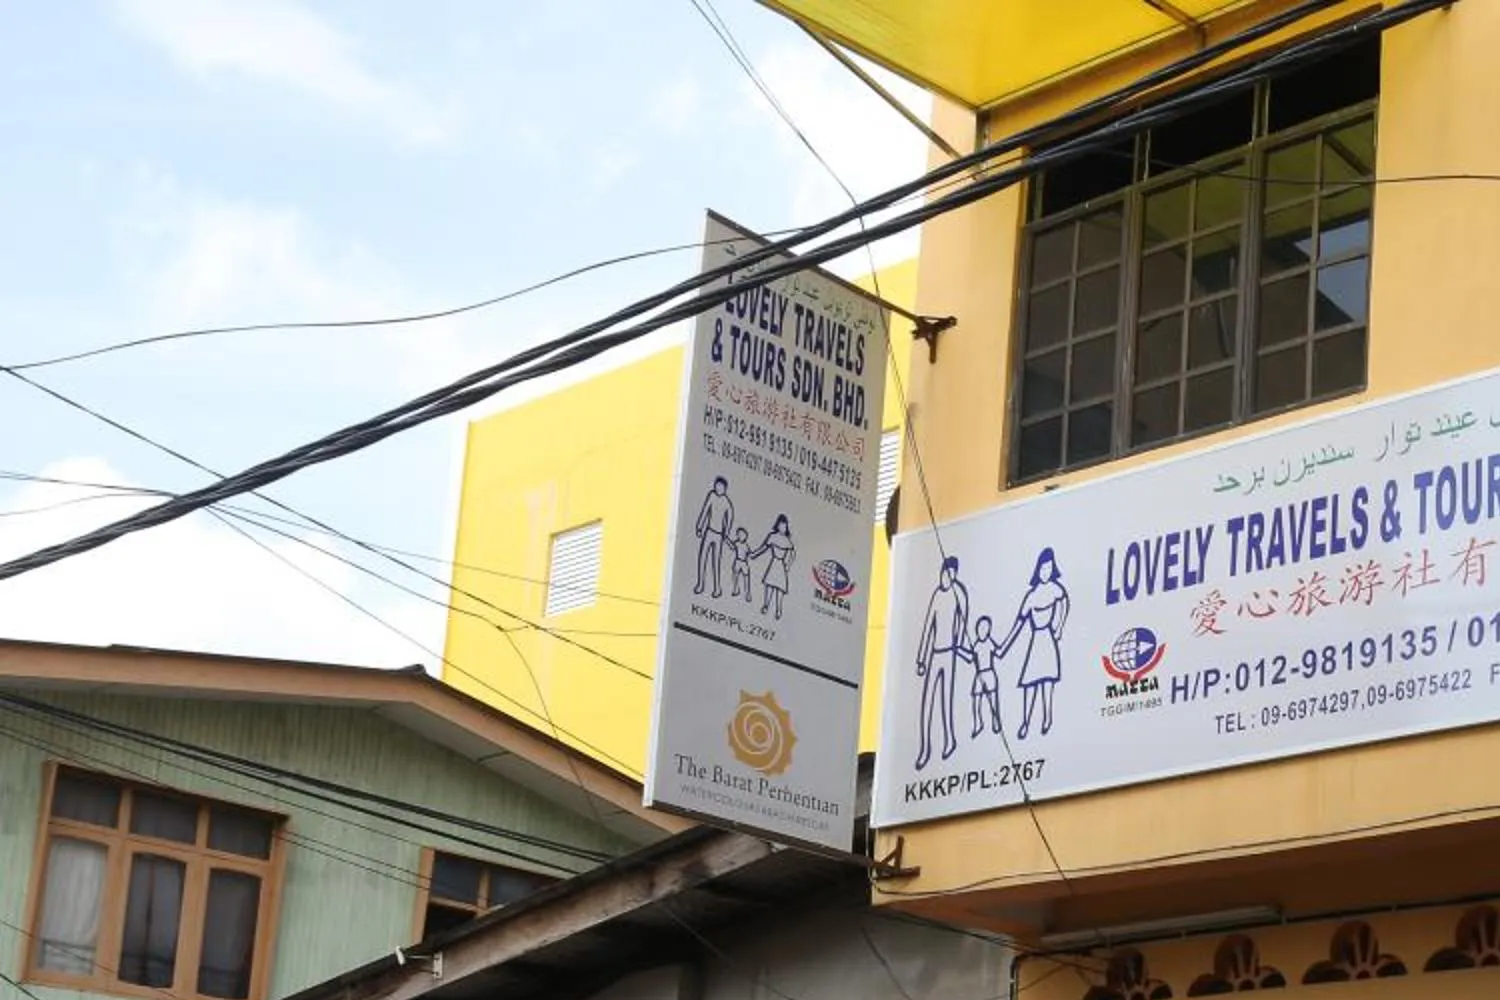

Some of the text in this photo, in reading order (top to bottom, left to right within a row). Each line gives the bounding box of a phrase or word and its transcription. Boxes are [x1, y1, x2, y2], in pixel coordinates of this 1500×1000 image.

[711, 318, 869, 430] & TOURS SDN. BHD.
[794, 303, 866, 376] TRAVELS
[1106, 523, 1215, 606] LOVELY
[1226, 485, 1369, 578] TRAVELS
[1380, 479, 1402, 543] &
[674, 753, 707, 779] The
[712, 765, 755, 793] Barat
[905, 759, 1045, 802] KKKP/PL:2767
